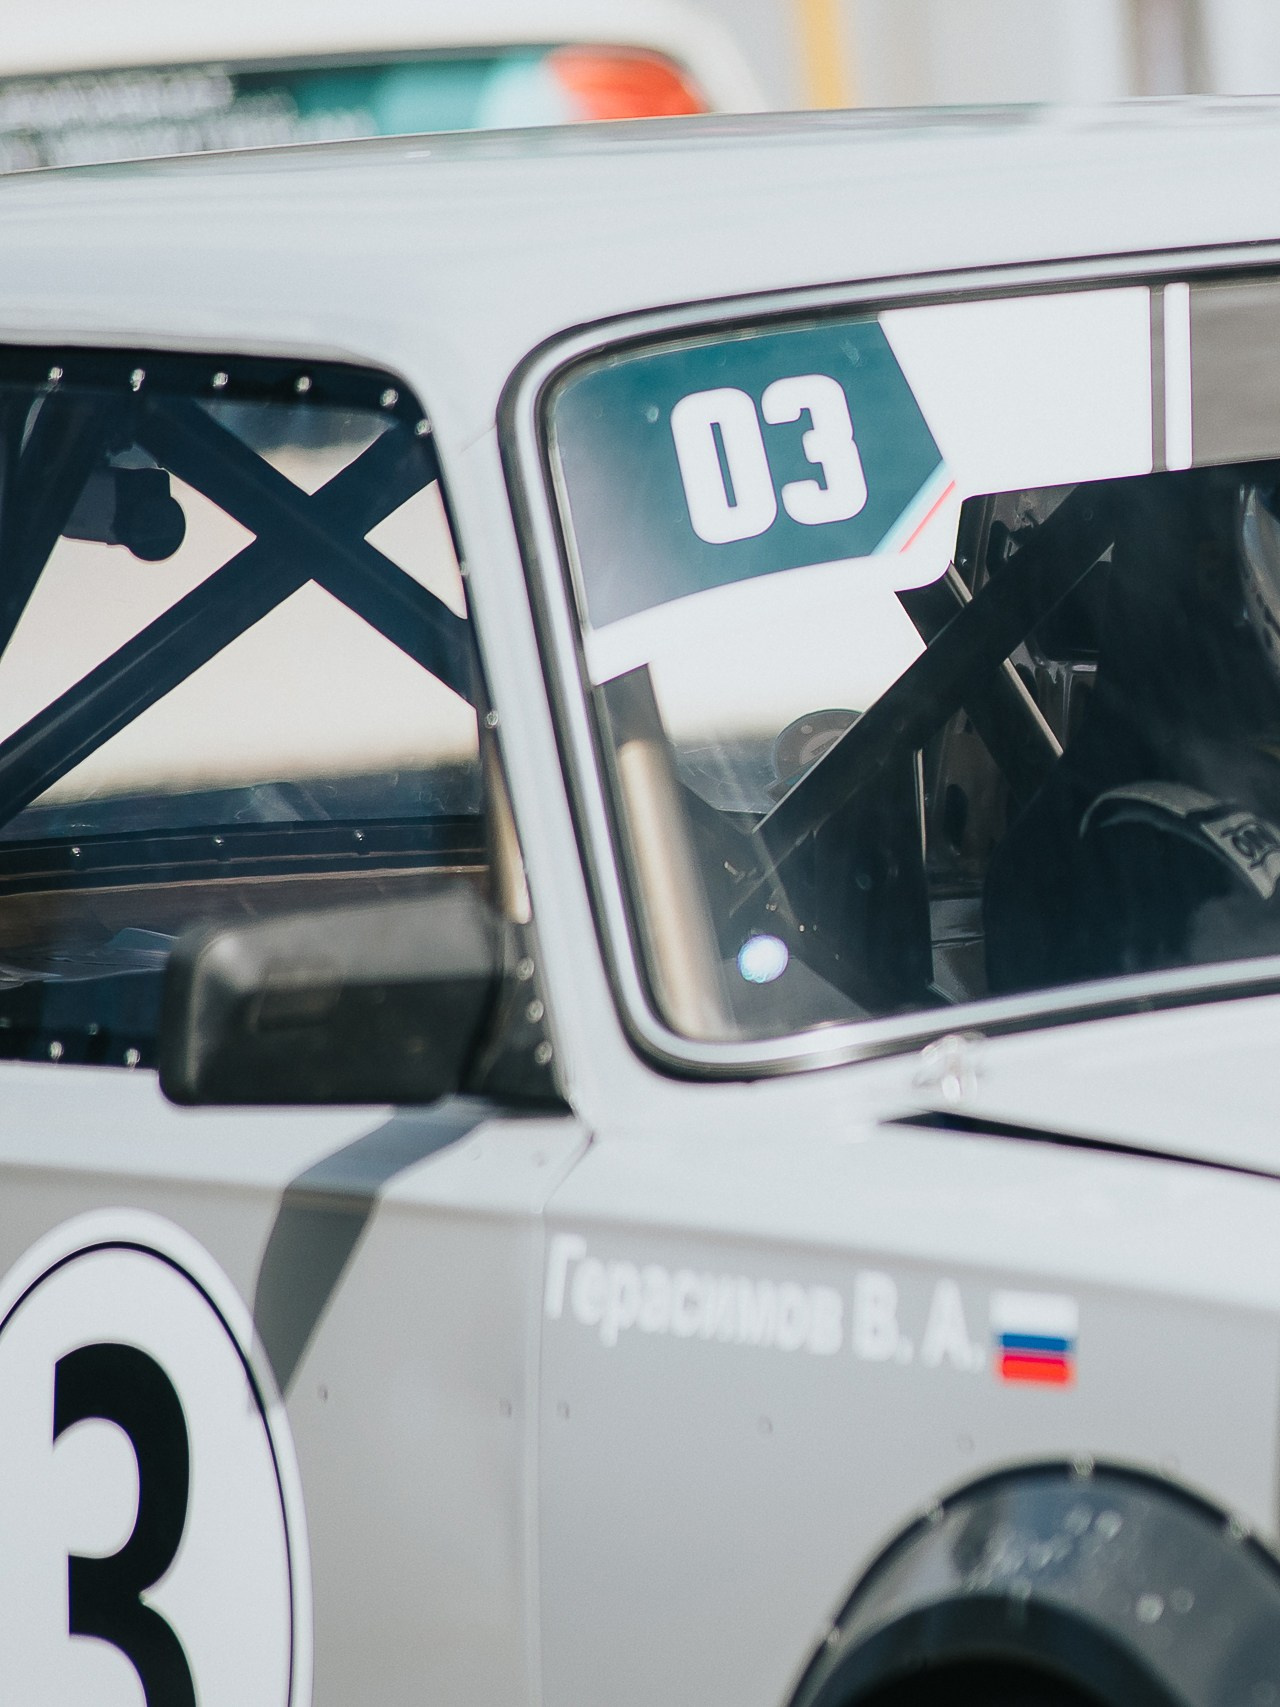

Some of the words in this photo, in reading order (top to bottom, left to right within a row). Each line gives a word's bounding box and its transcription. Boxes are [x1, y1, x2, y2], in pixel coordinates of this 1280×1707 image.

[670, 374, 867, 544] 03
[545, 1234, 844, 1355] Герасимов
[852, 1270, 914, 1364] В.
[921, 1279, 986, 1372] А.
[52, 1343, 197, 1707] 3
